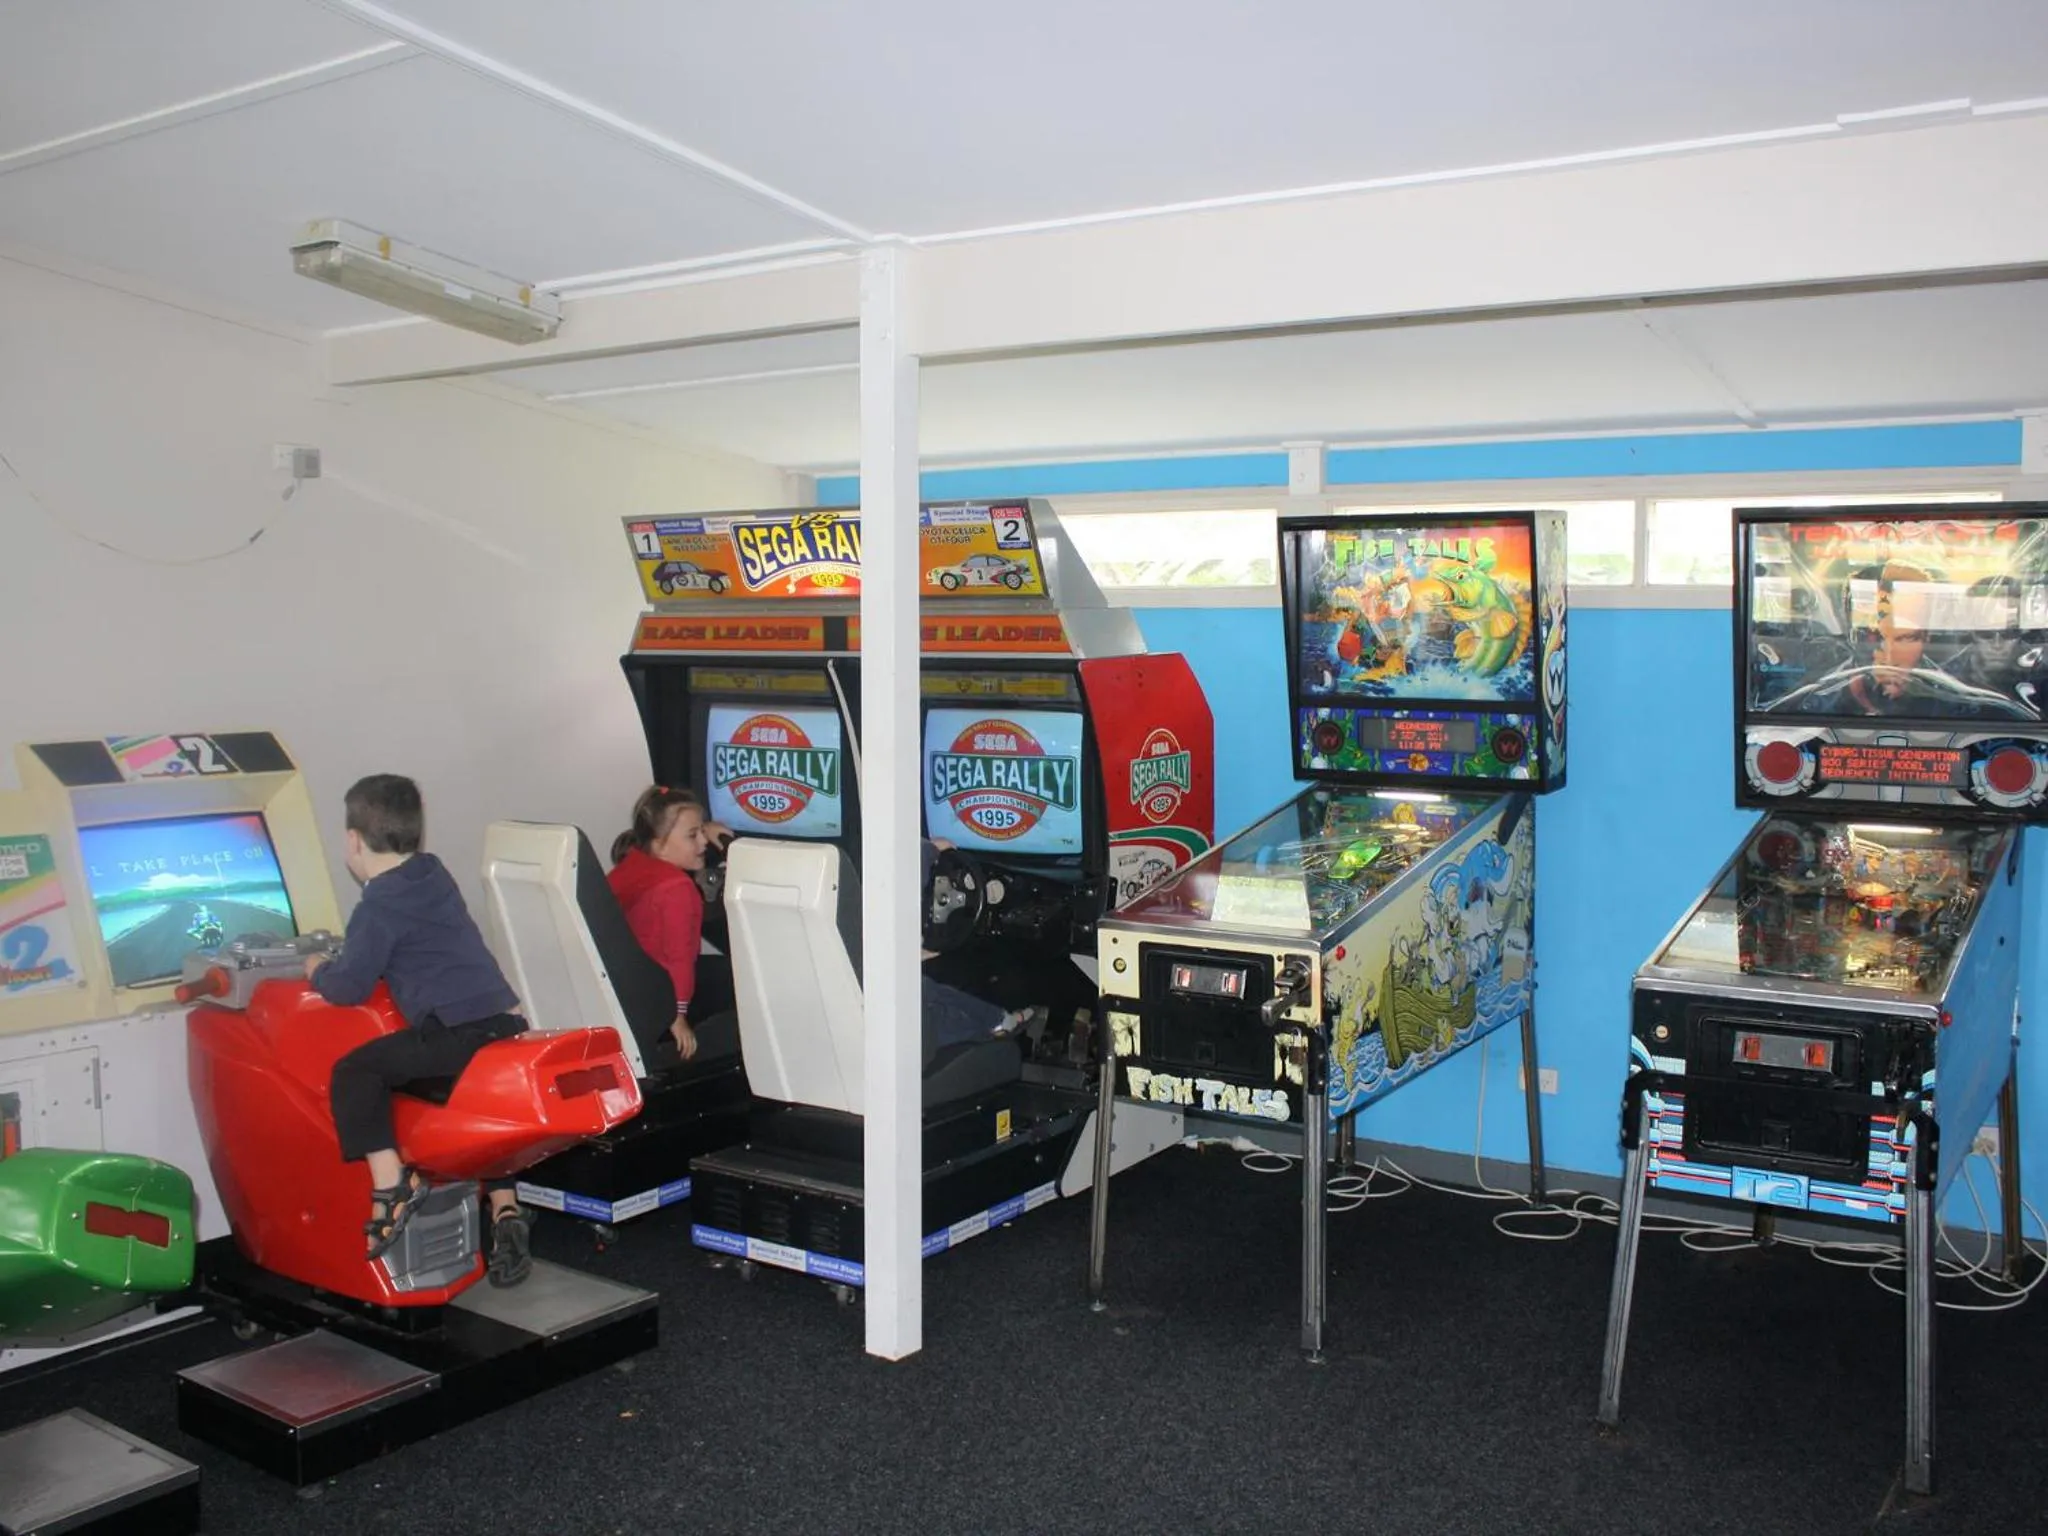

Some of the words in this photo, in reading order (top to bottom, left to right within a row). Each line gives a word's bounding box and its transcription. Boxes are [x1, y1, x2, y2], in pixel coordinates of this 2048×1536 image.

[1004, 520, 1020, 541] 2
[643, 534, 651, 552] 1
[738, 526, 813, 579] SEGA
[813, 525, 861, 563] RAL
[1334, 539, 1394, 568] FISH
[1408, 537, 1497, 571] TALES
[642, 626, 706, 641] RACE
[713, 626, 810, 641] LEADER
[945, 626, 1062, 642] LEADER
[750, 727, 788, 744] SEGA
[974, 733, 1017, 751] SEGA
[180, 737, 228, 772] 2
[716, 746, 761, 783] SEGA
[765, 750, 834, 791] RALLY
[934, 756, 986, 798] SEGA
[992, 760, 1070, 804] RALLY
[1133, 761, 1159, 797] SEGA
[1160, 756, 1188, 787] RALLY
[752, 795, 786, 811] 1995
[977, 810, 1016, 827] 1995
[119, 858, 168, 874] TAKE
[179, 850, 233, 867] PLACE
[1127, 1066, 1194, 1105] FISH
[1195, 1078, 1291, 1122] TALES
[1737, 1169, 1802, 1206] T2
